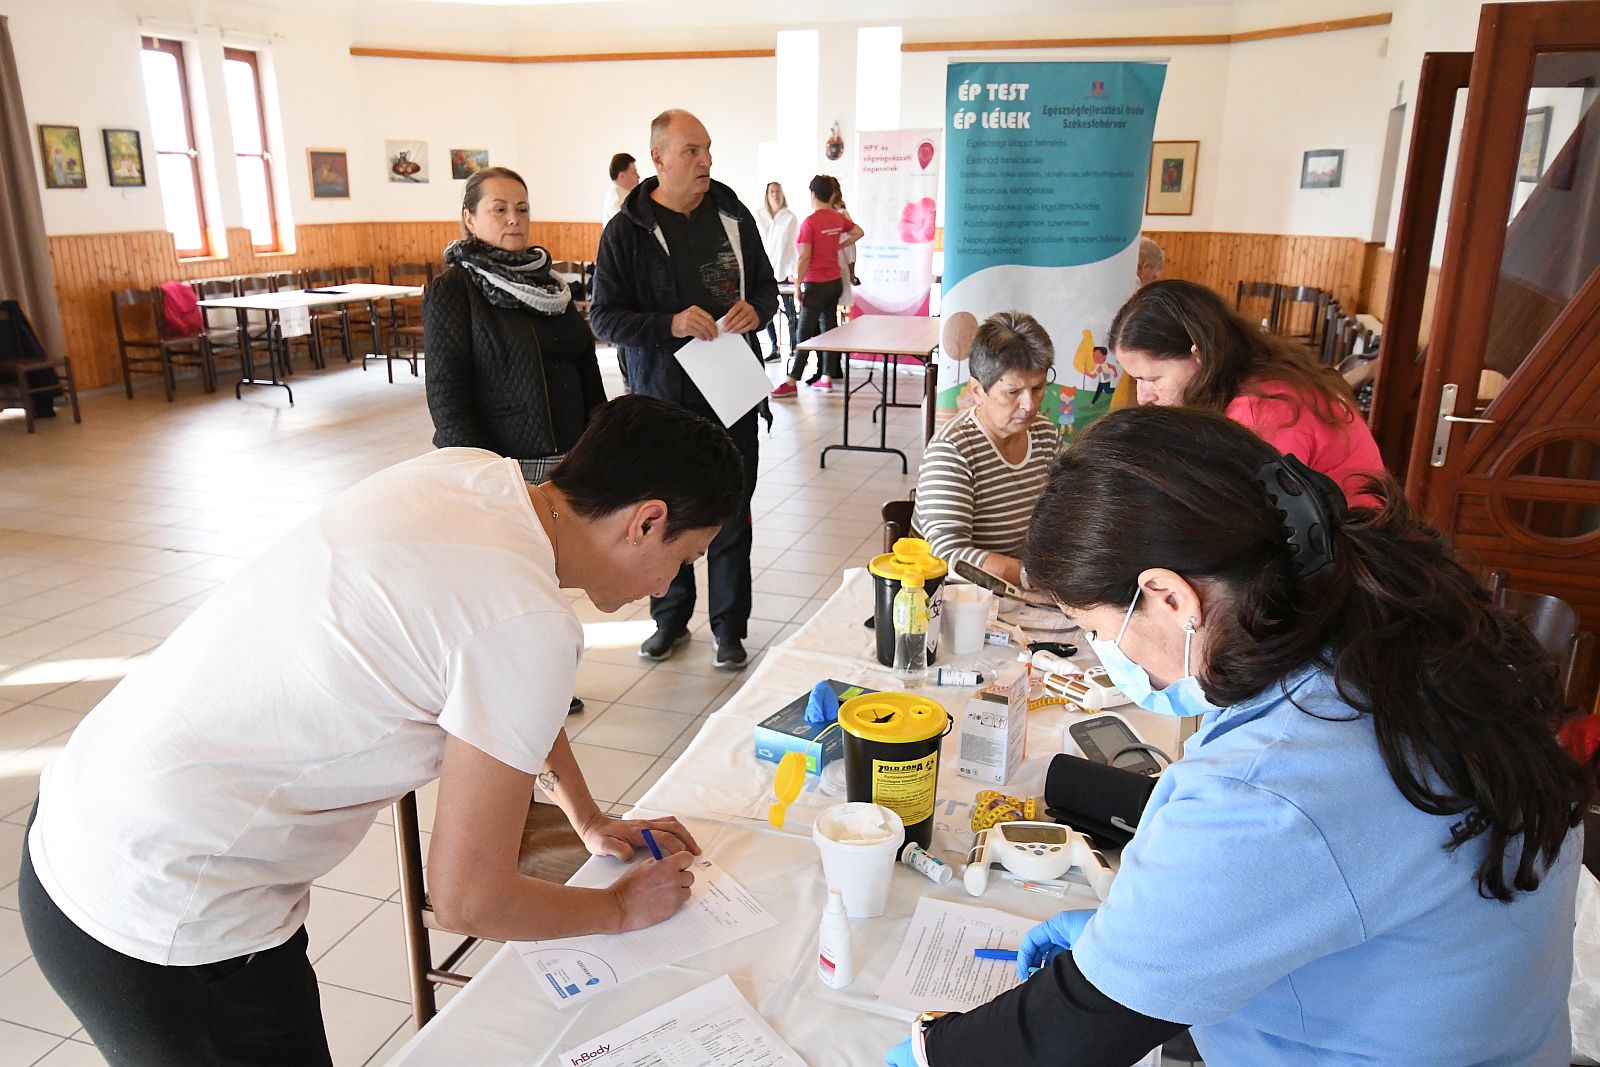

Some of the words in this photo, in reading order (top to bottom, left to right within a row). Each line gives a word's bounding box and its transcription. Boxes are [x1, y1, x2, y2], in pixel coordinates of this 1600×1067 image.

[958, 80, 982, 101] ÉP
[986, 83, 1030, 101] TEST
[953, 107, 977, 129] ÉP
[981, 107, 1032, 129] LÉLEK
[570, 1043, 610, 1067] InBody
